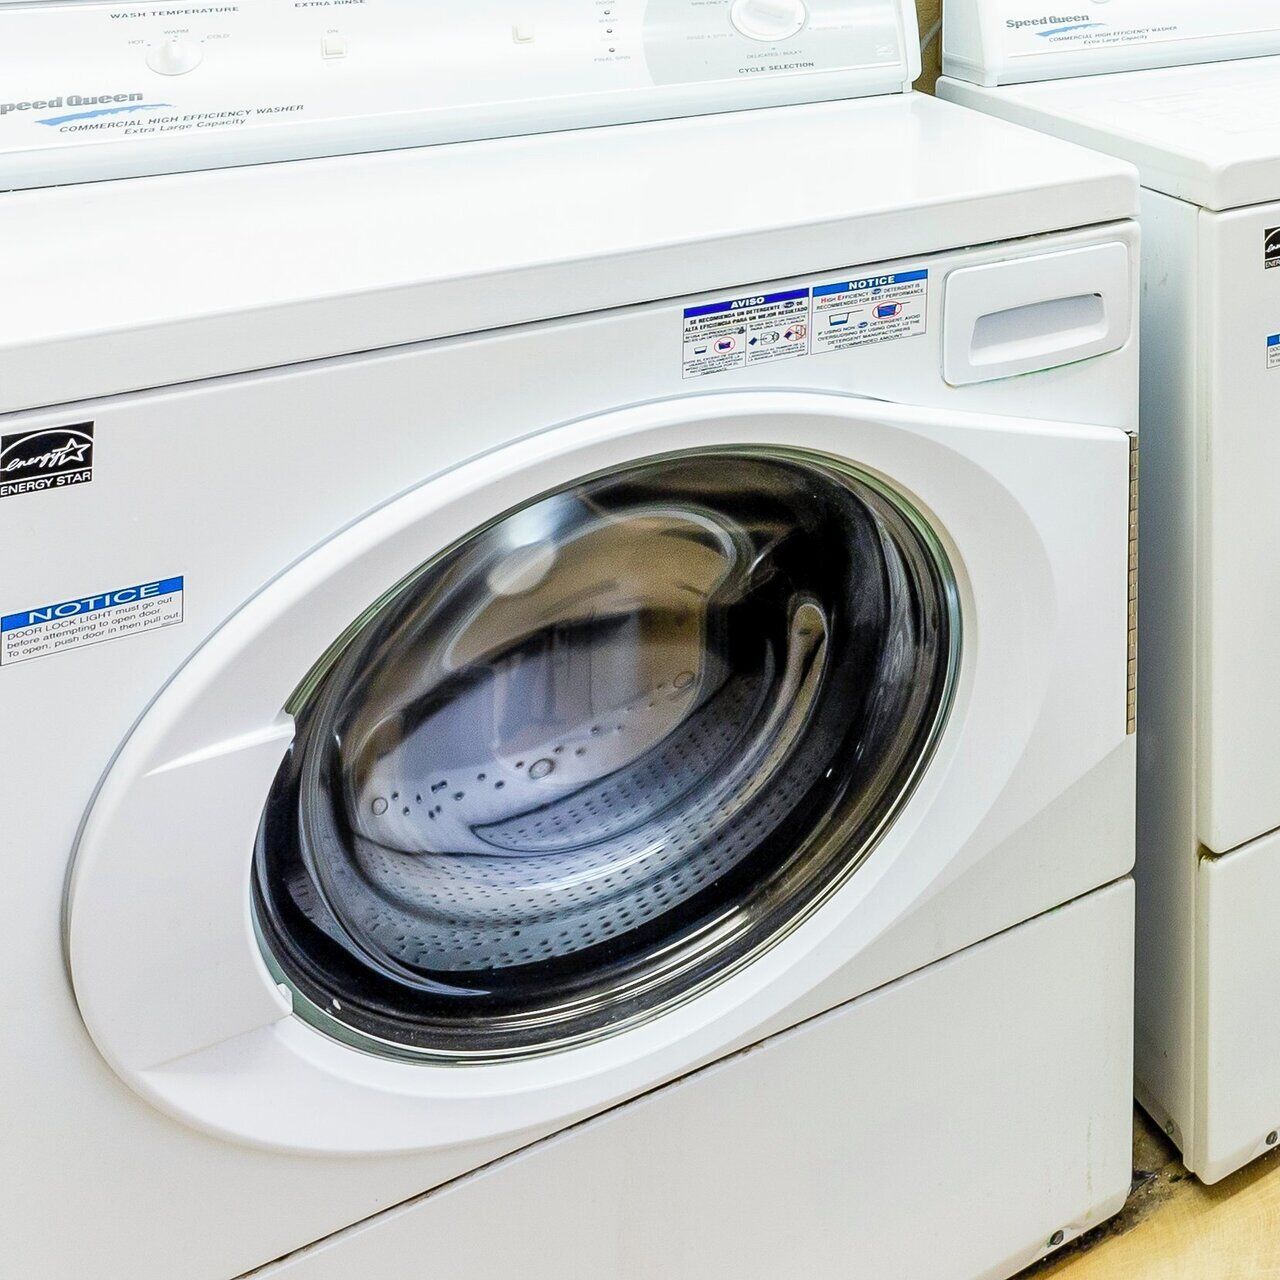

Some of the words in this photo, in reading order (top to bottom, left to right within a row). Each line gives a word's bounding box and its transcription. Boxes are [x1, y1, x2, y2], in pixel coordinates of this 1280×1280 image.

[110, 11, 147, 20] WASH
[150, 6, 240, 17] TEMPERATURE
[294, 0, 332, 8] EXTRA
[1006, 16, 1047, 29] Speed
[1049, 14, 1090, 24] Queen
[1049, 33, 1093, 43] COMMERCIAL
[1113, 28, 1150, 37] EFFICIENCY
[738, 65, 766, 75] CYCLE
[768, 61, 815, 72] SELECTION
[0, 97, 63, 115] peed
[66, 92, 144, 108] Queen
[60, 119, 143, 133] COMMERCIAL
[148, 115, 179, 125] HIGH
[182, 109, 252, 123] EFFICIENCY
[256, 104, 305, 115] WASHER
[124, 126, 156, 135] Extra
[159, 122, 193, 134] Large
[196, 117, 247, 131] Capacity
[848, 275, 895, 290] NOTICE
[883, 284, 914, 294] DETERGENT
[730, 297, 765, 309] AVISO
[816, 299, 858, 311] RECOMMENDED
[871, 294, 884, 302] BEST
[885, 288, 924, 300] PERFORMANCE
[698, 313, 735, 324] RECOMIENDA
[746, 305, 780, 316] DETERGENTE
[700, 319, 731, 331] EFICIENCIA
[732, 316, 748, 325] PARA
[758, 311, 777, 320] MEJOR
[778, 306, 808, 317] RESULTADO
[824, 327, 841, 336] USING
[905, 314, 921, 322] AVOID
[868, 325, 885, 333] USING
[886, 322, 900, 330] ONLY
[828, 335, 861, 347] DETERGENT
[834, 337, 879, 350] RECOMMENDED
[5, 451, 62, 471] energy
[0, 477, 54, 496] ENERGY
[56, 471, 91, 486] STAR
[29, 582, 160, 624] NOTICE
[7, 626, 42, 641] DOOR
[45, 619, 76, 632] LOCK
[80, 609, 113, 624] LIGHT
[115, 603, 140, 614] must
[142, 601, 154, 610] go
[157, 596, 173, 605] out
[7, 636, 40, 650] before
[43, 624, 96, 642] attempting
[99, 619, 109, 627] to
[111, 613, 136, 626] open
[54, 635, 80, 648] push
[82, 629, 105, 640] door
[107, 625, 117, 634] in
[120, 619, 142, 631] then
[144, 614, 161, 626] pull
